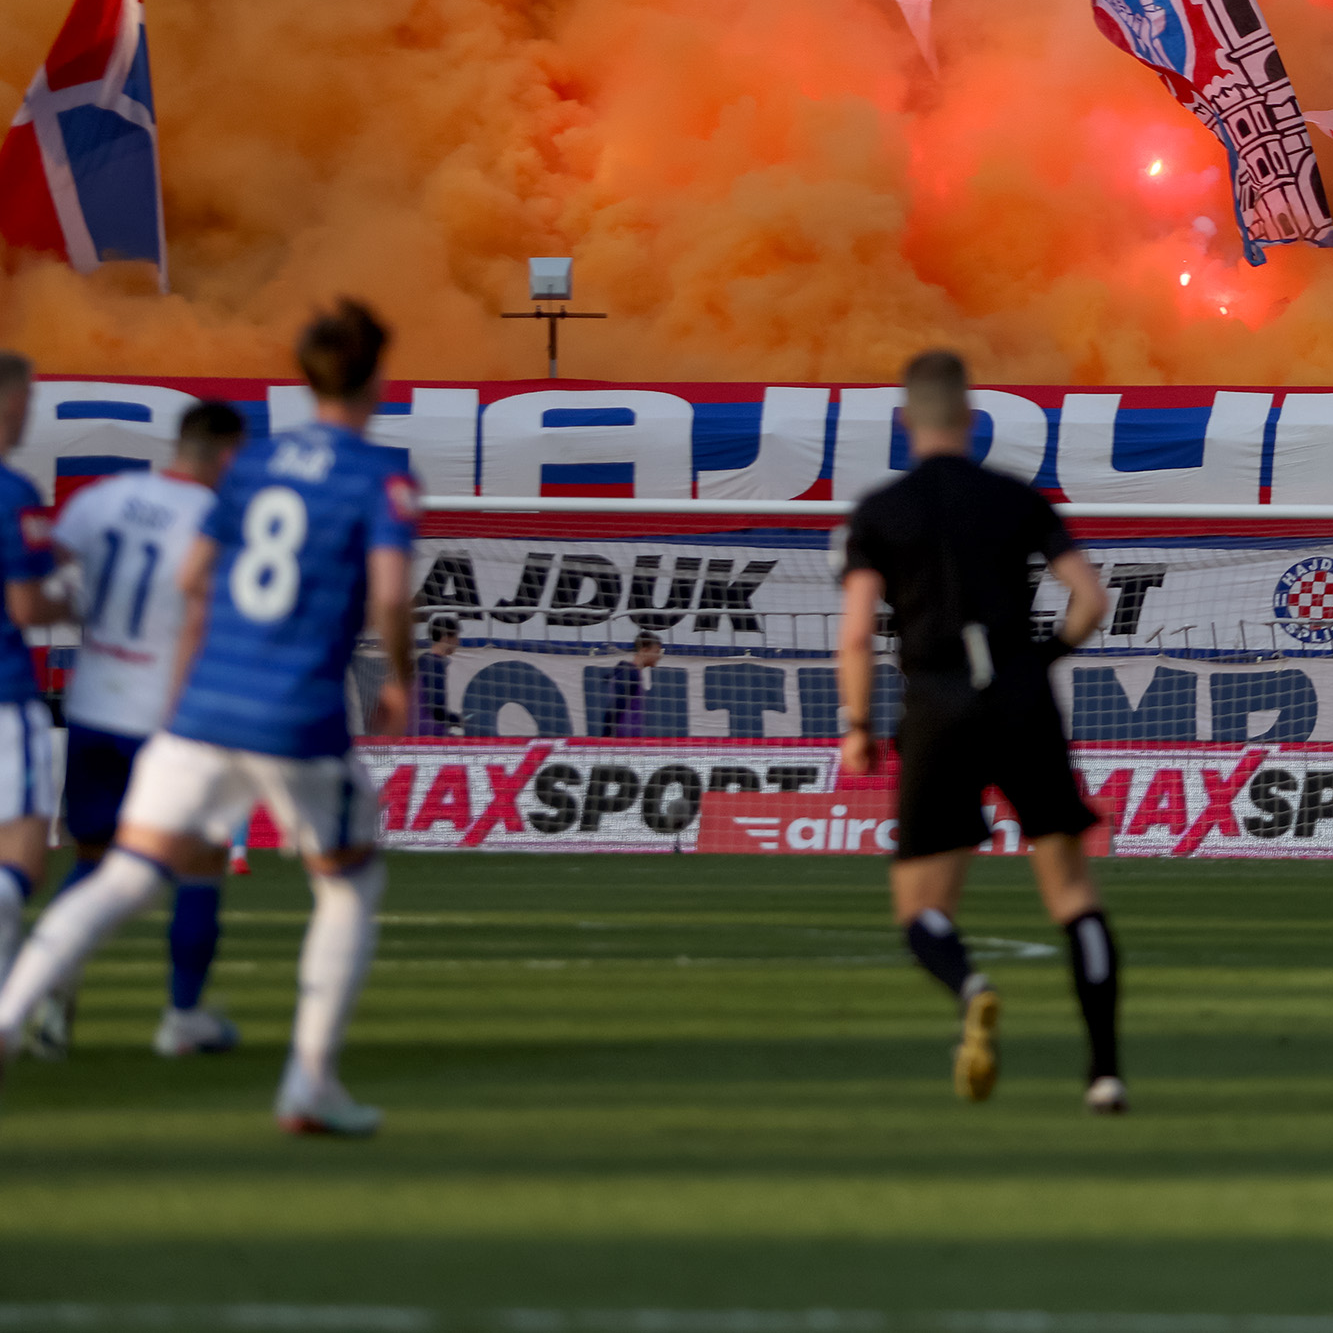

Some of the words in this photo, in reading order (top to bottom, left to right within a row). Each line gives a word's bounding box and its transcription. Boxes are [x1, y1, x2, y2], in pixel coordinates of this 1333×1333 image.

[86, 529, 162, 640] 11
[229, 487, 308, 624] 8
[413, 551, 779, 633] AJDUK
